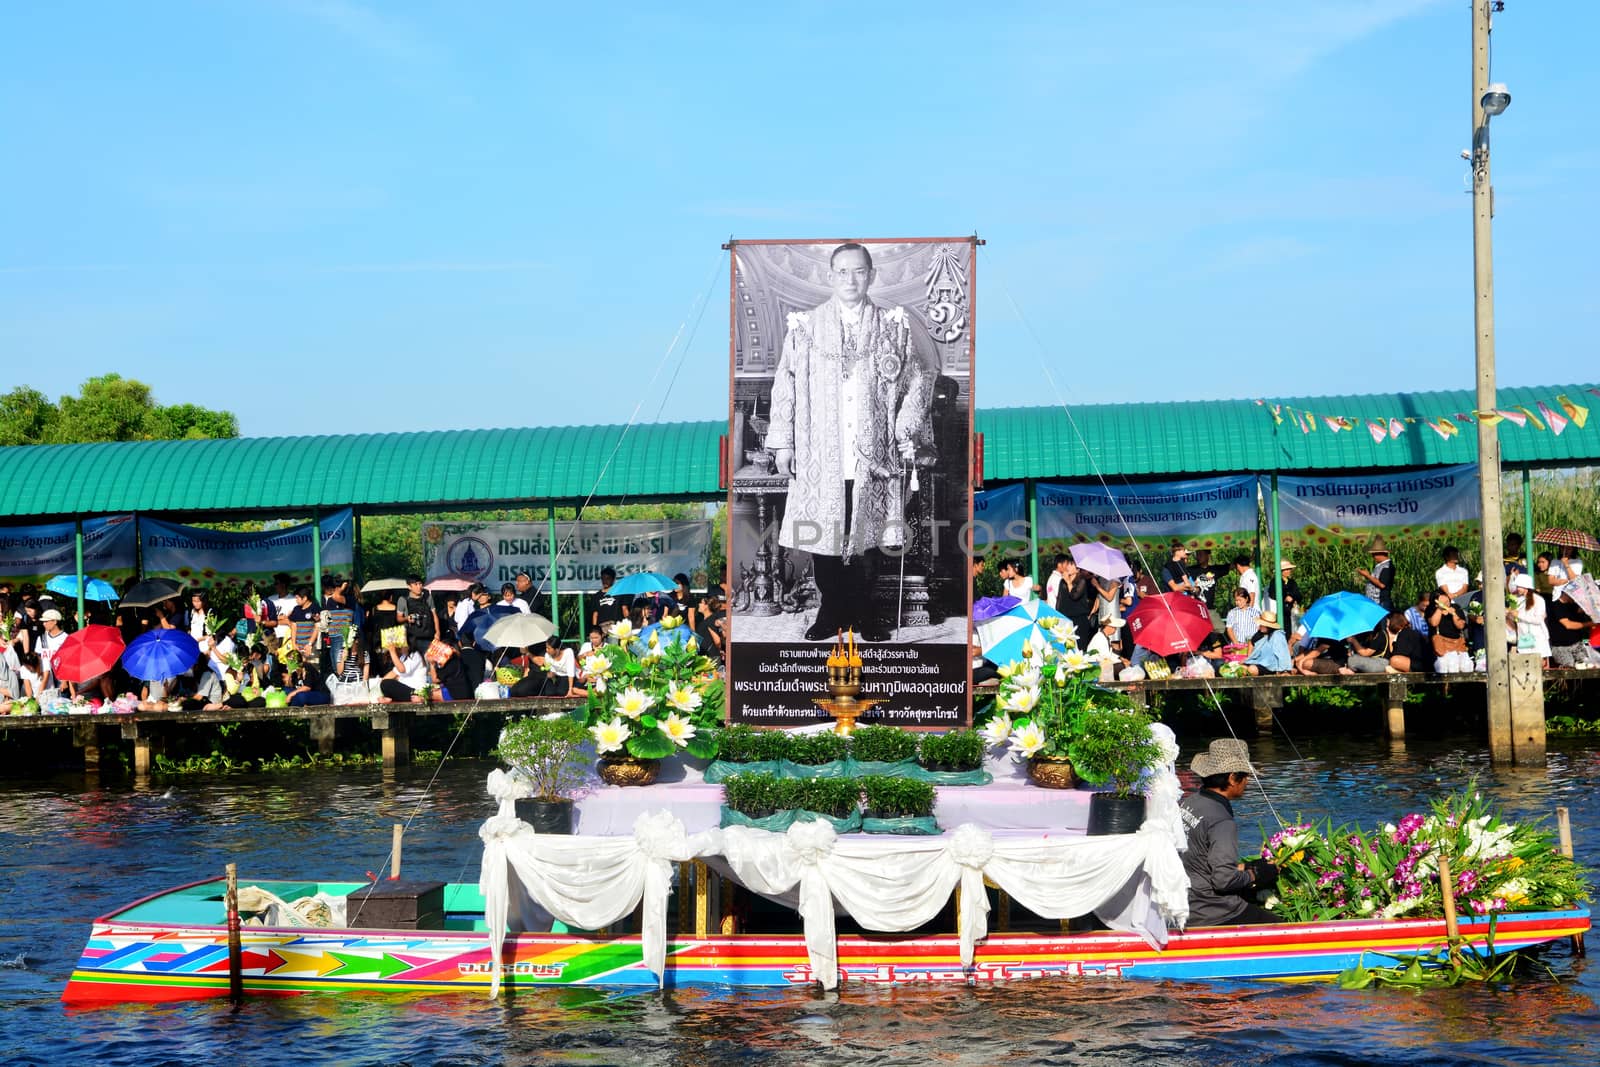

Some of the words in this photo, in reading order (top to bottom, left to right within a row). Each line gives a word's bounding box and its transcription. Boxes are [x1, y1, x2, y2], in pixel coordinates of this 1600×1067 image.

[1335, 497, 1420, 518] ลาดกระบัง
[499, 533, 672, 555] กรมส่งสริมวัฒนธรรม
